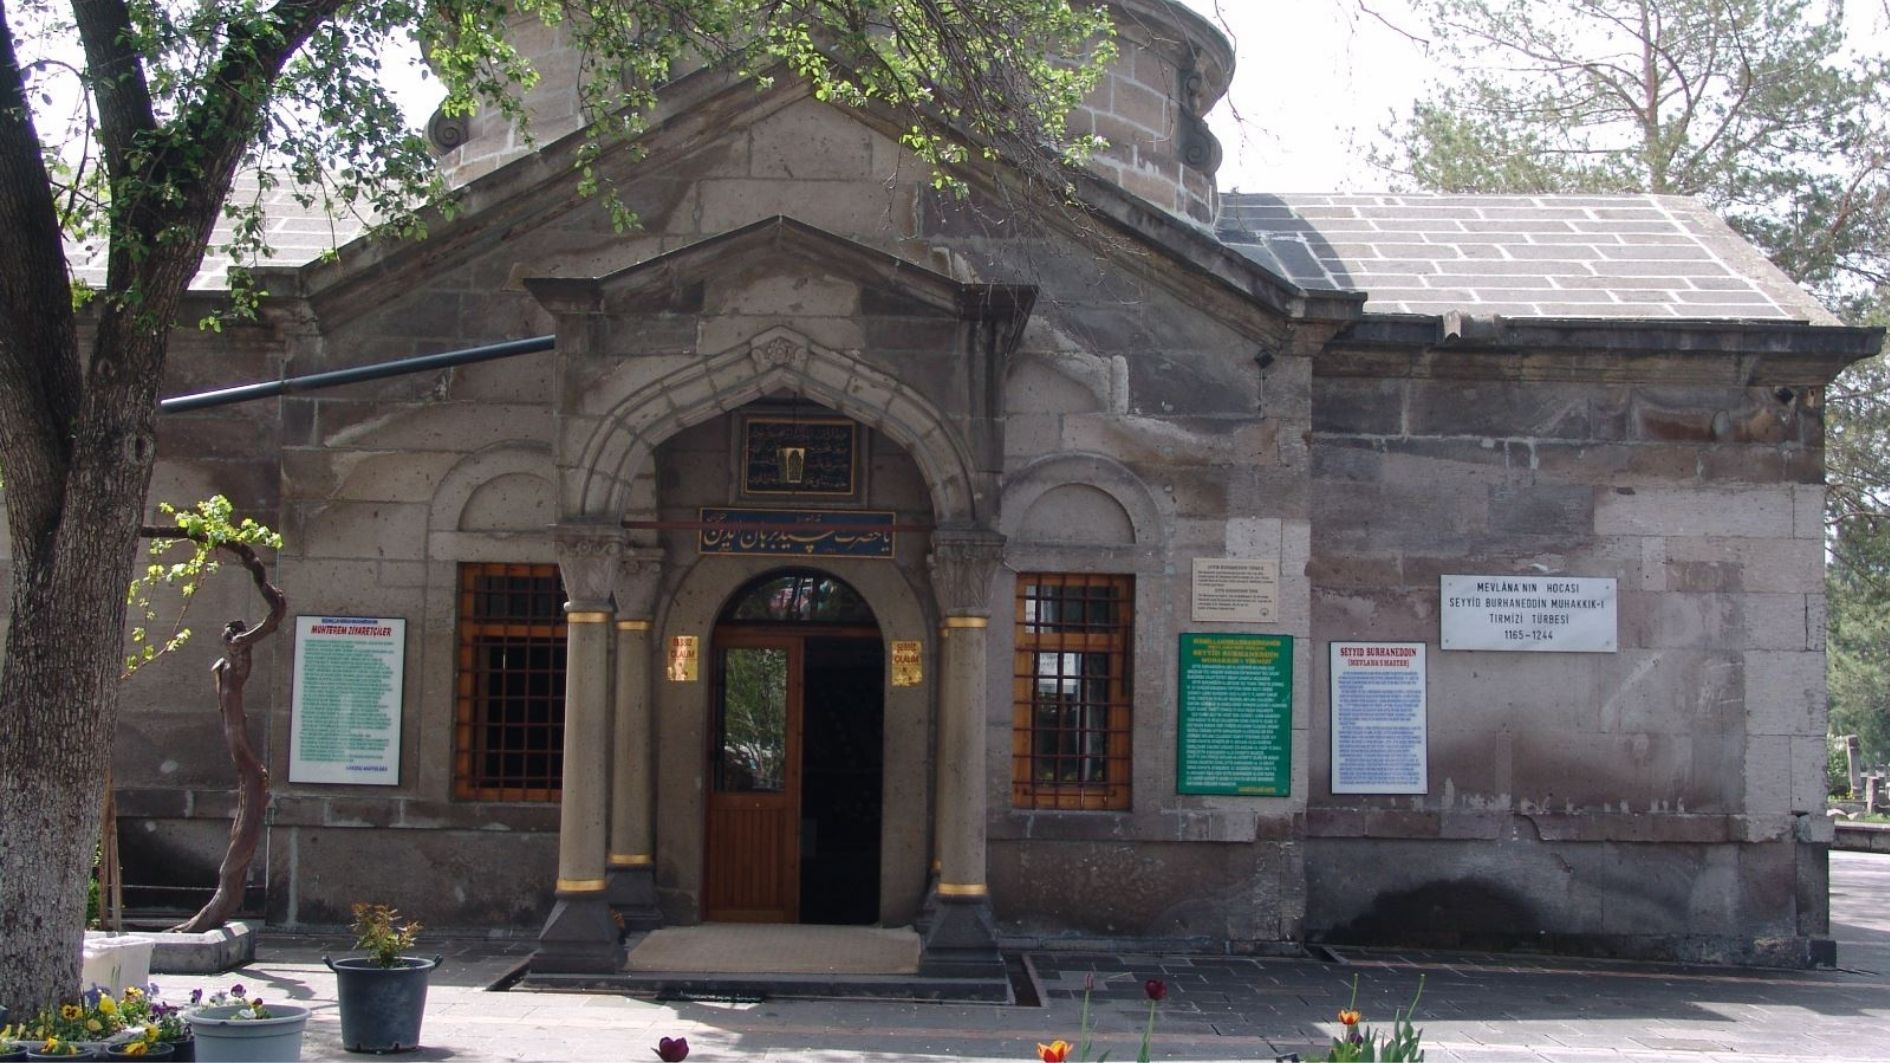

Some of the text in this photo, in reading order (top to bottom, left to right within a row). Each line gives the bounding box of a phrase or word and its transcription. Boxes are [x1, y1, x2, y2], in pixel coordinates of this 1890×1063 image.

[1546, 583, 1579, 593] HOCASI
[1449, 596, 1481, 608] SEYYİD
[1485, 597, 1547, 608] BURHANEDDİN
[1532, 613, 1569, 624] TÜRBESİ
[1504, 630, 1553, 640] 1165-1244
